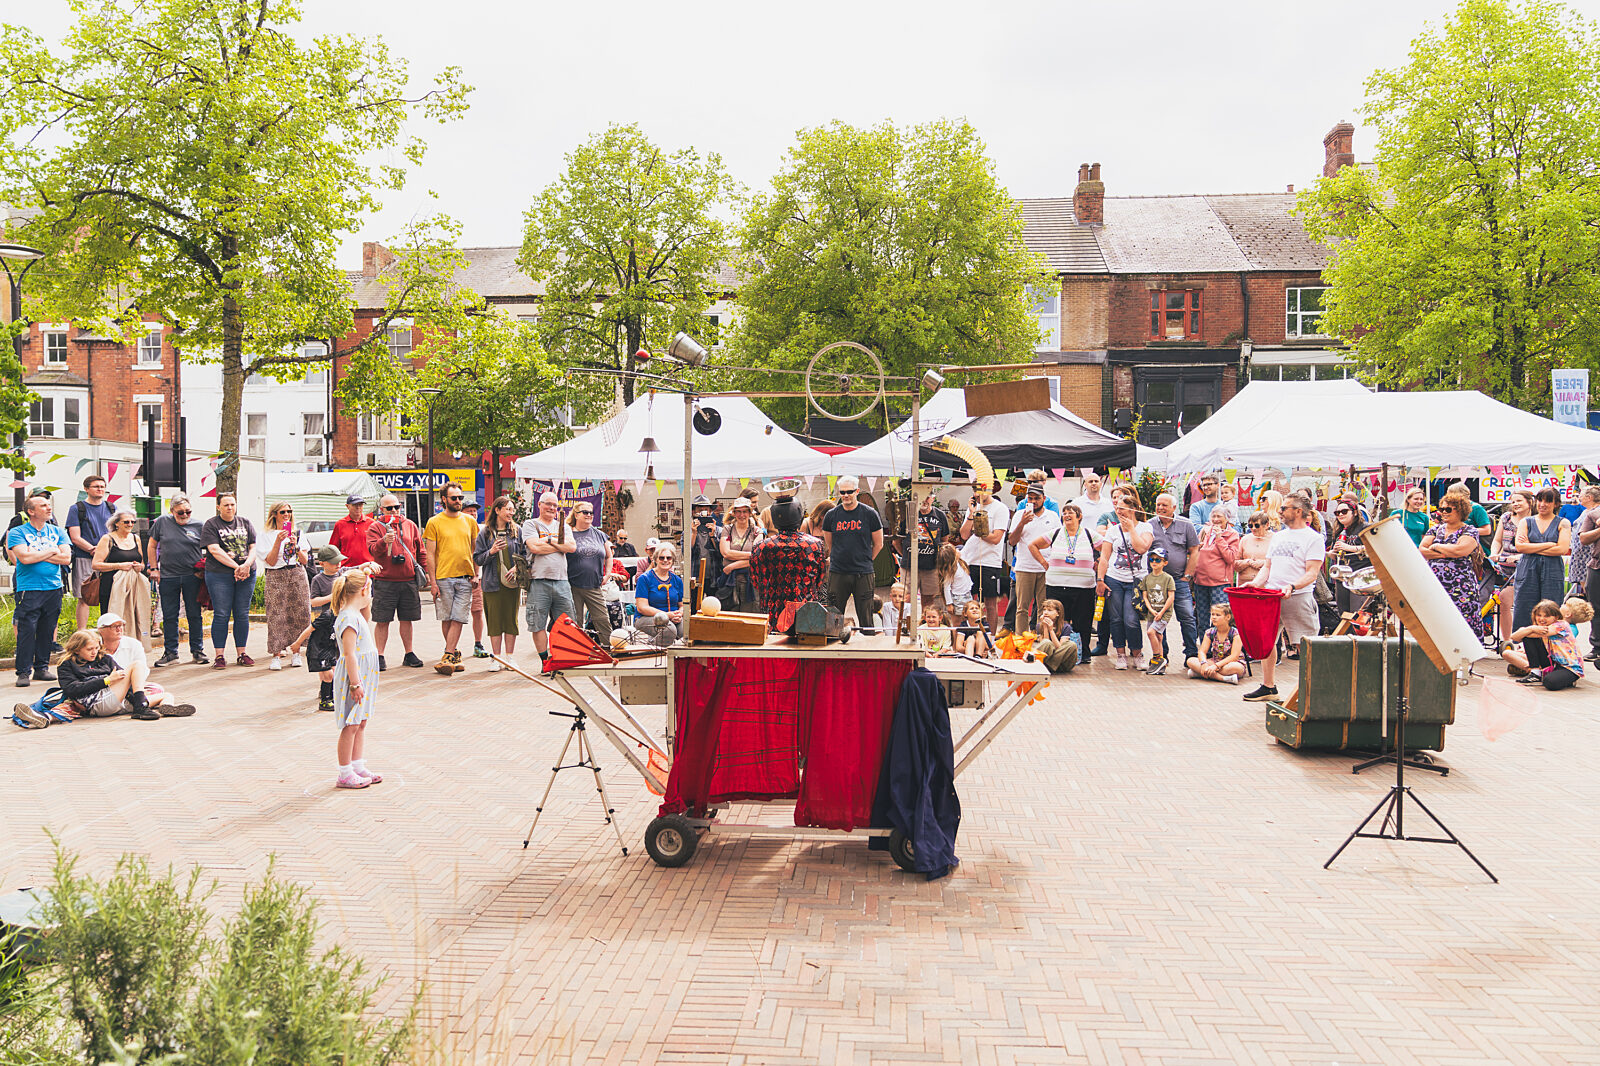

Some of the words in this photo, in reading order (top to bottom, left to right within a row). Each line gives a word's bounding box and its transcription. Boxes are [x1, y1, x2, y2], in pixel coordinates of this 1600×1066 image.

[1484, 464, 1549, 475] WLCME
[405, 475, 414, 487] 4
[416, 474, 446, 487] YOU
[1481, 477, 1522, 488] CRICH
[1524, 476, 1566, 488] SHARE
